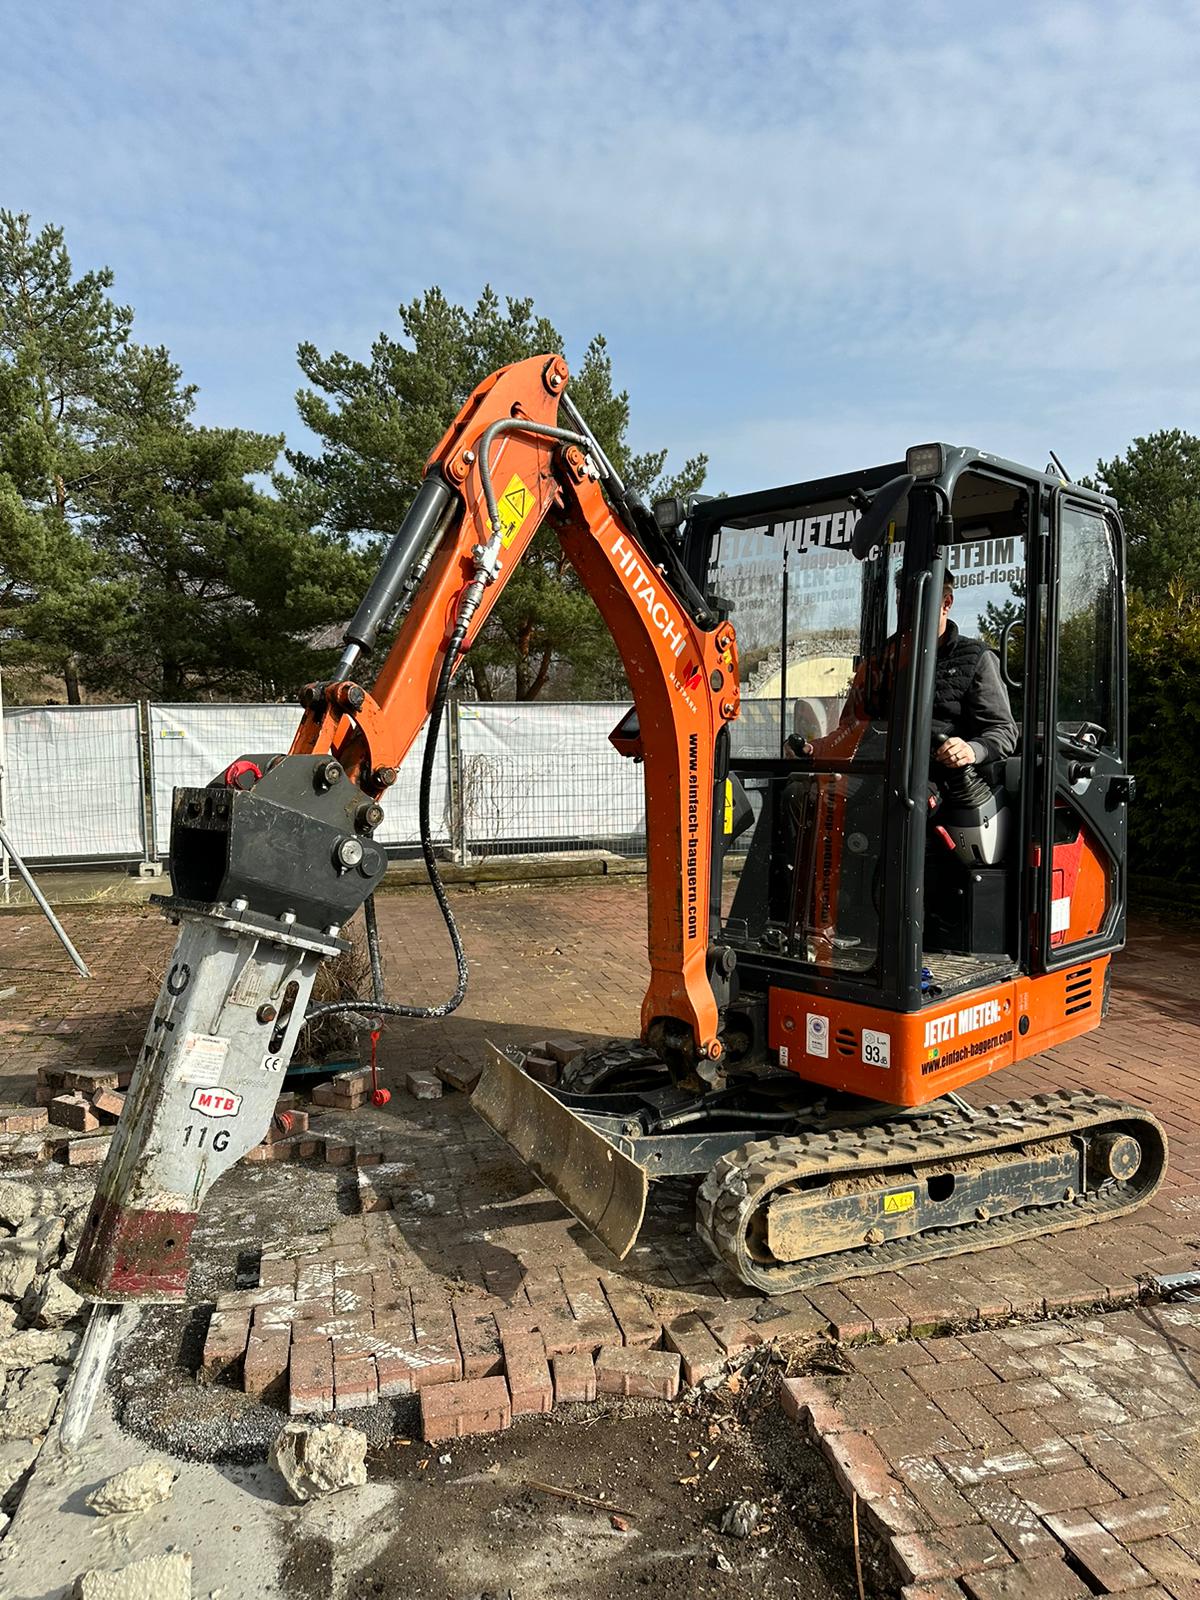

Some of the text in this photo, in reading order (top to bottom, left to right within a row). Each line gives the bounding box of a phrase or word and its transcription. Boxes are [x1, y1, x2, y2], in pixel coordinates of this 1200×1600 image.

[708, 525, 770, 564] JETZT
[611, 535, 687, 657] HITACHI
[687, 733, 699, 940] www.einfach-baggern.com
[924, 1012, 957, 1048] JETZT
[958, 999, 1001, 1035] MIETEN:
[865, 1044, 880, 1063] 93
[921, 1030, 1013, 1075] www.einfach-baggern.com
[198, 1093, 235, 1111] MTB
